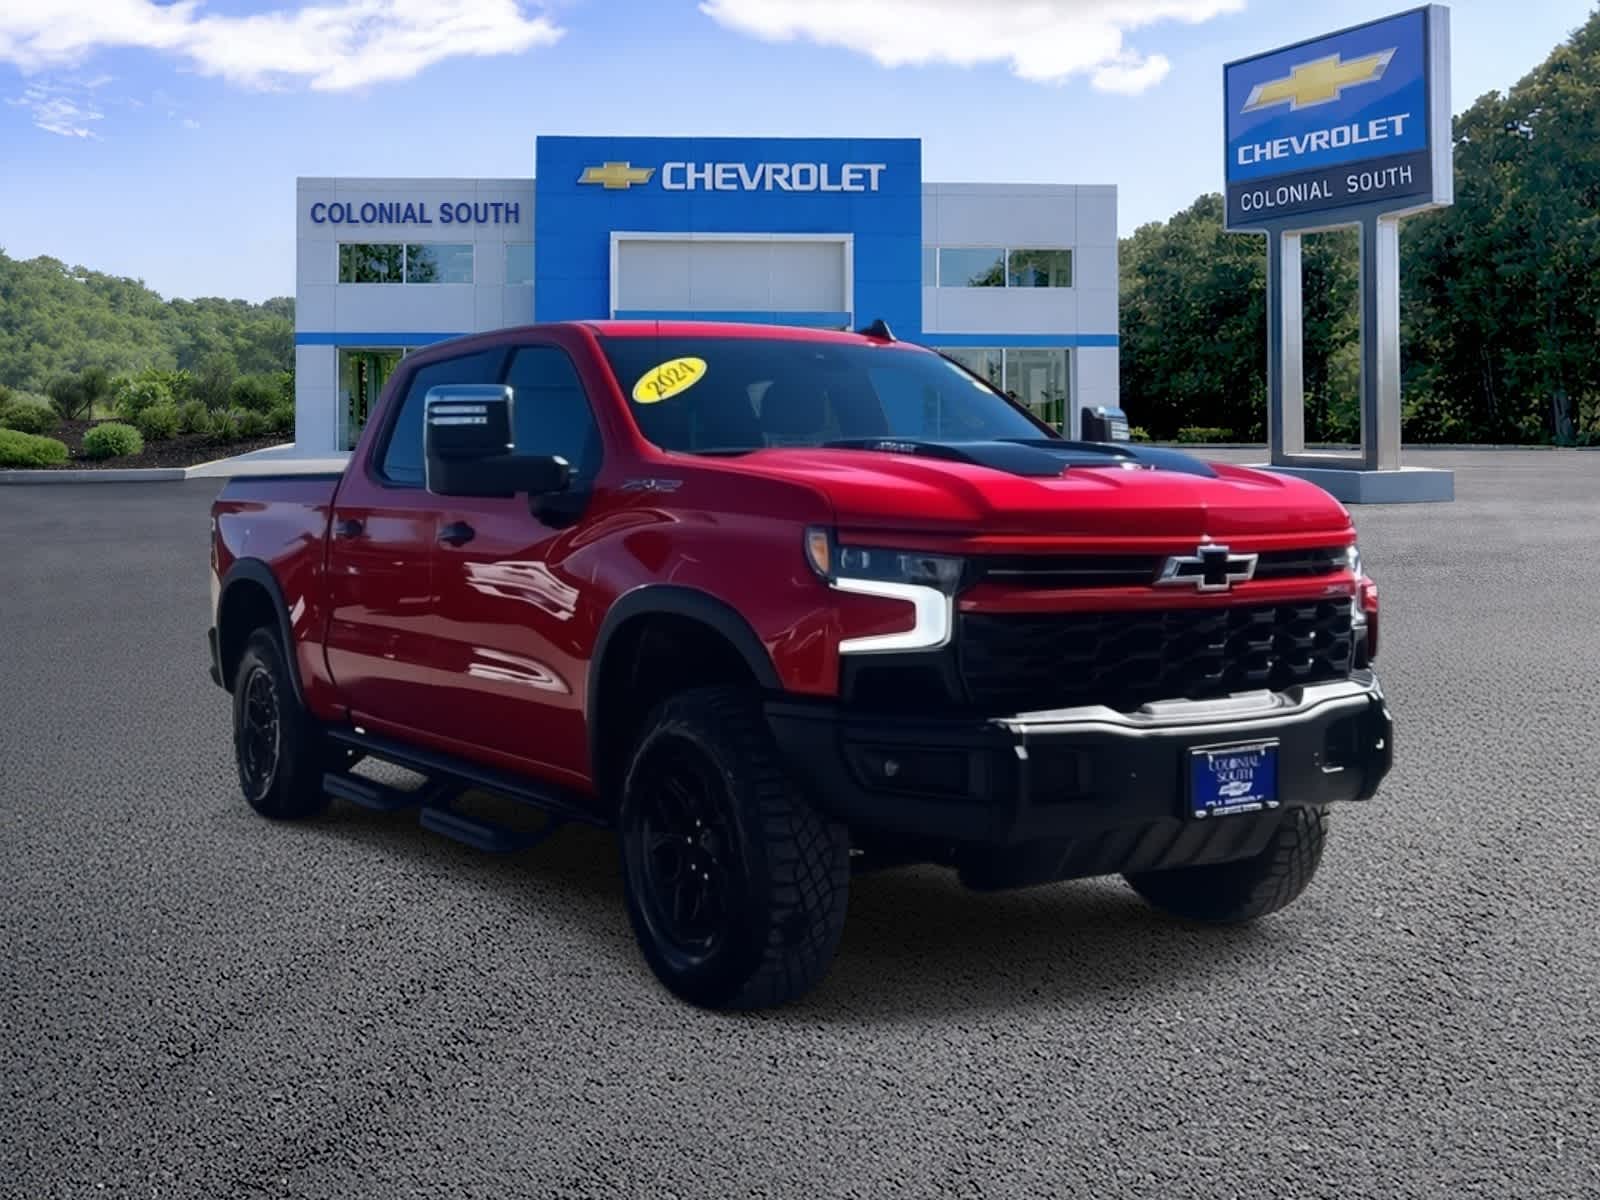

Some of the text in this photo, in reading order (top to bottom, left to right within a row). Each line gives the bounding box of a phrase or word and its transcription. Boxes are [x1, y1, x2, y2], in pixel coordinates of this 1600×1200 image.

[1238, 113, 1410, 165] CHEVROLET
[662, 161, 887, 192] CHEVROLET
[1241, 165, 1413, 211] COLONIAL SOUTH
[310, 202, 520, 224] COLONIAL SOUTH
[646, 361, 696, 397] 2024
